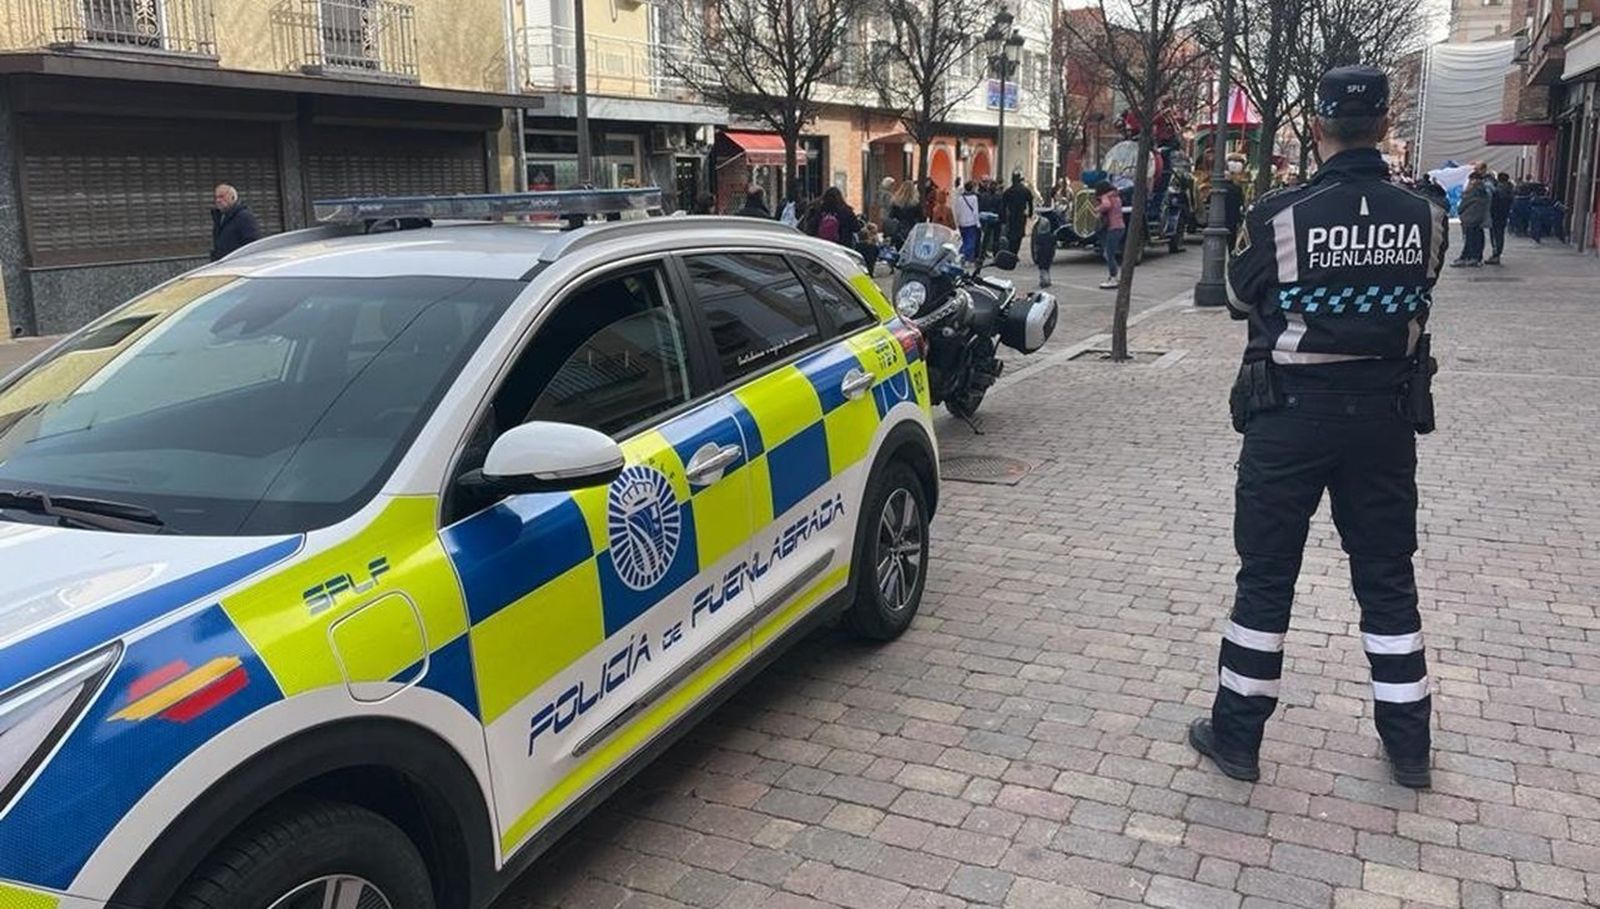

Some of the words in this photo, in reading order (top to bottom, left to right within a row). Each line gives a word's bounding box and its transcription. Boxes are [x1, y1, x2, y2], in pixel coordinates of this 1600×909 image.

[1307, 224, 1422, 252] POLICIA
[1309, 249, 1423, 268] FUENLABRADA
[303, 556, 390, 616] SPLF
[528, 631, 651, 756] POLICÍA
[662, 622, 682, 650] DE
[691, 493, 845, 627] FUENLABRADA
